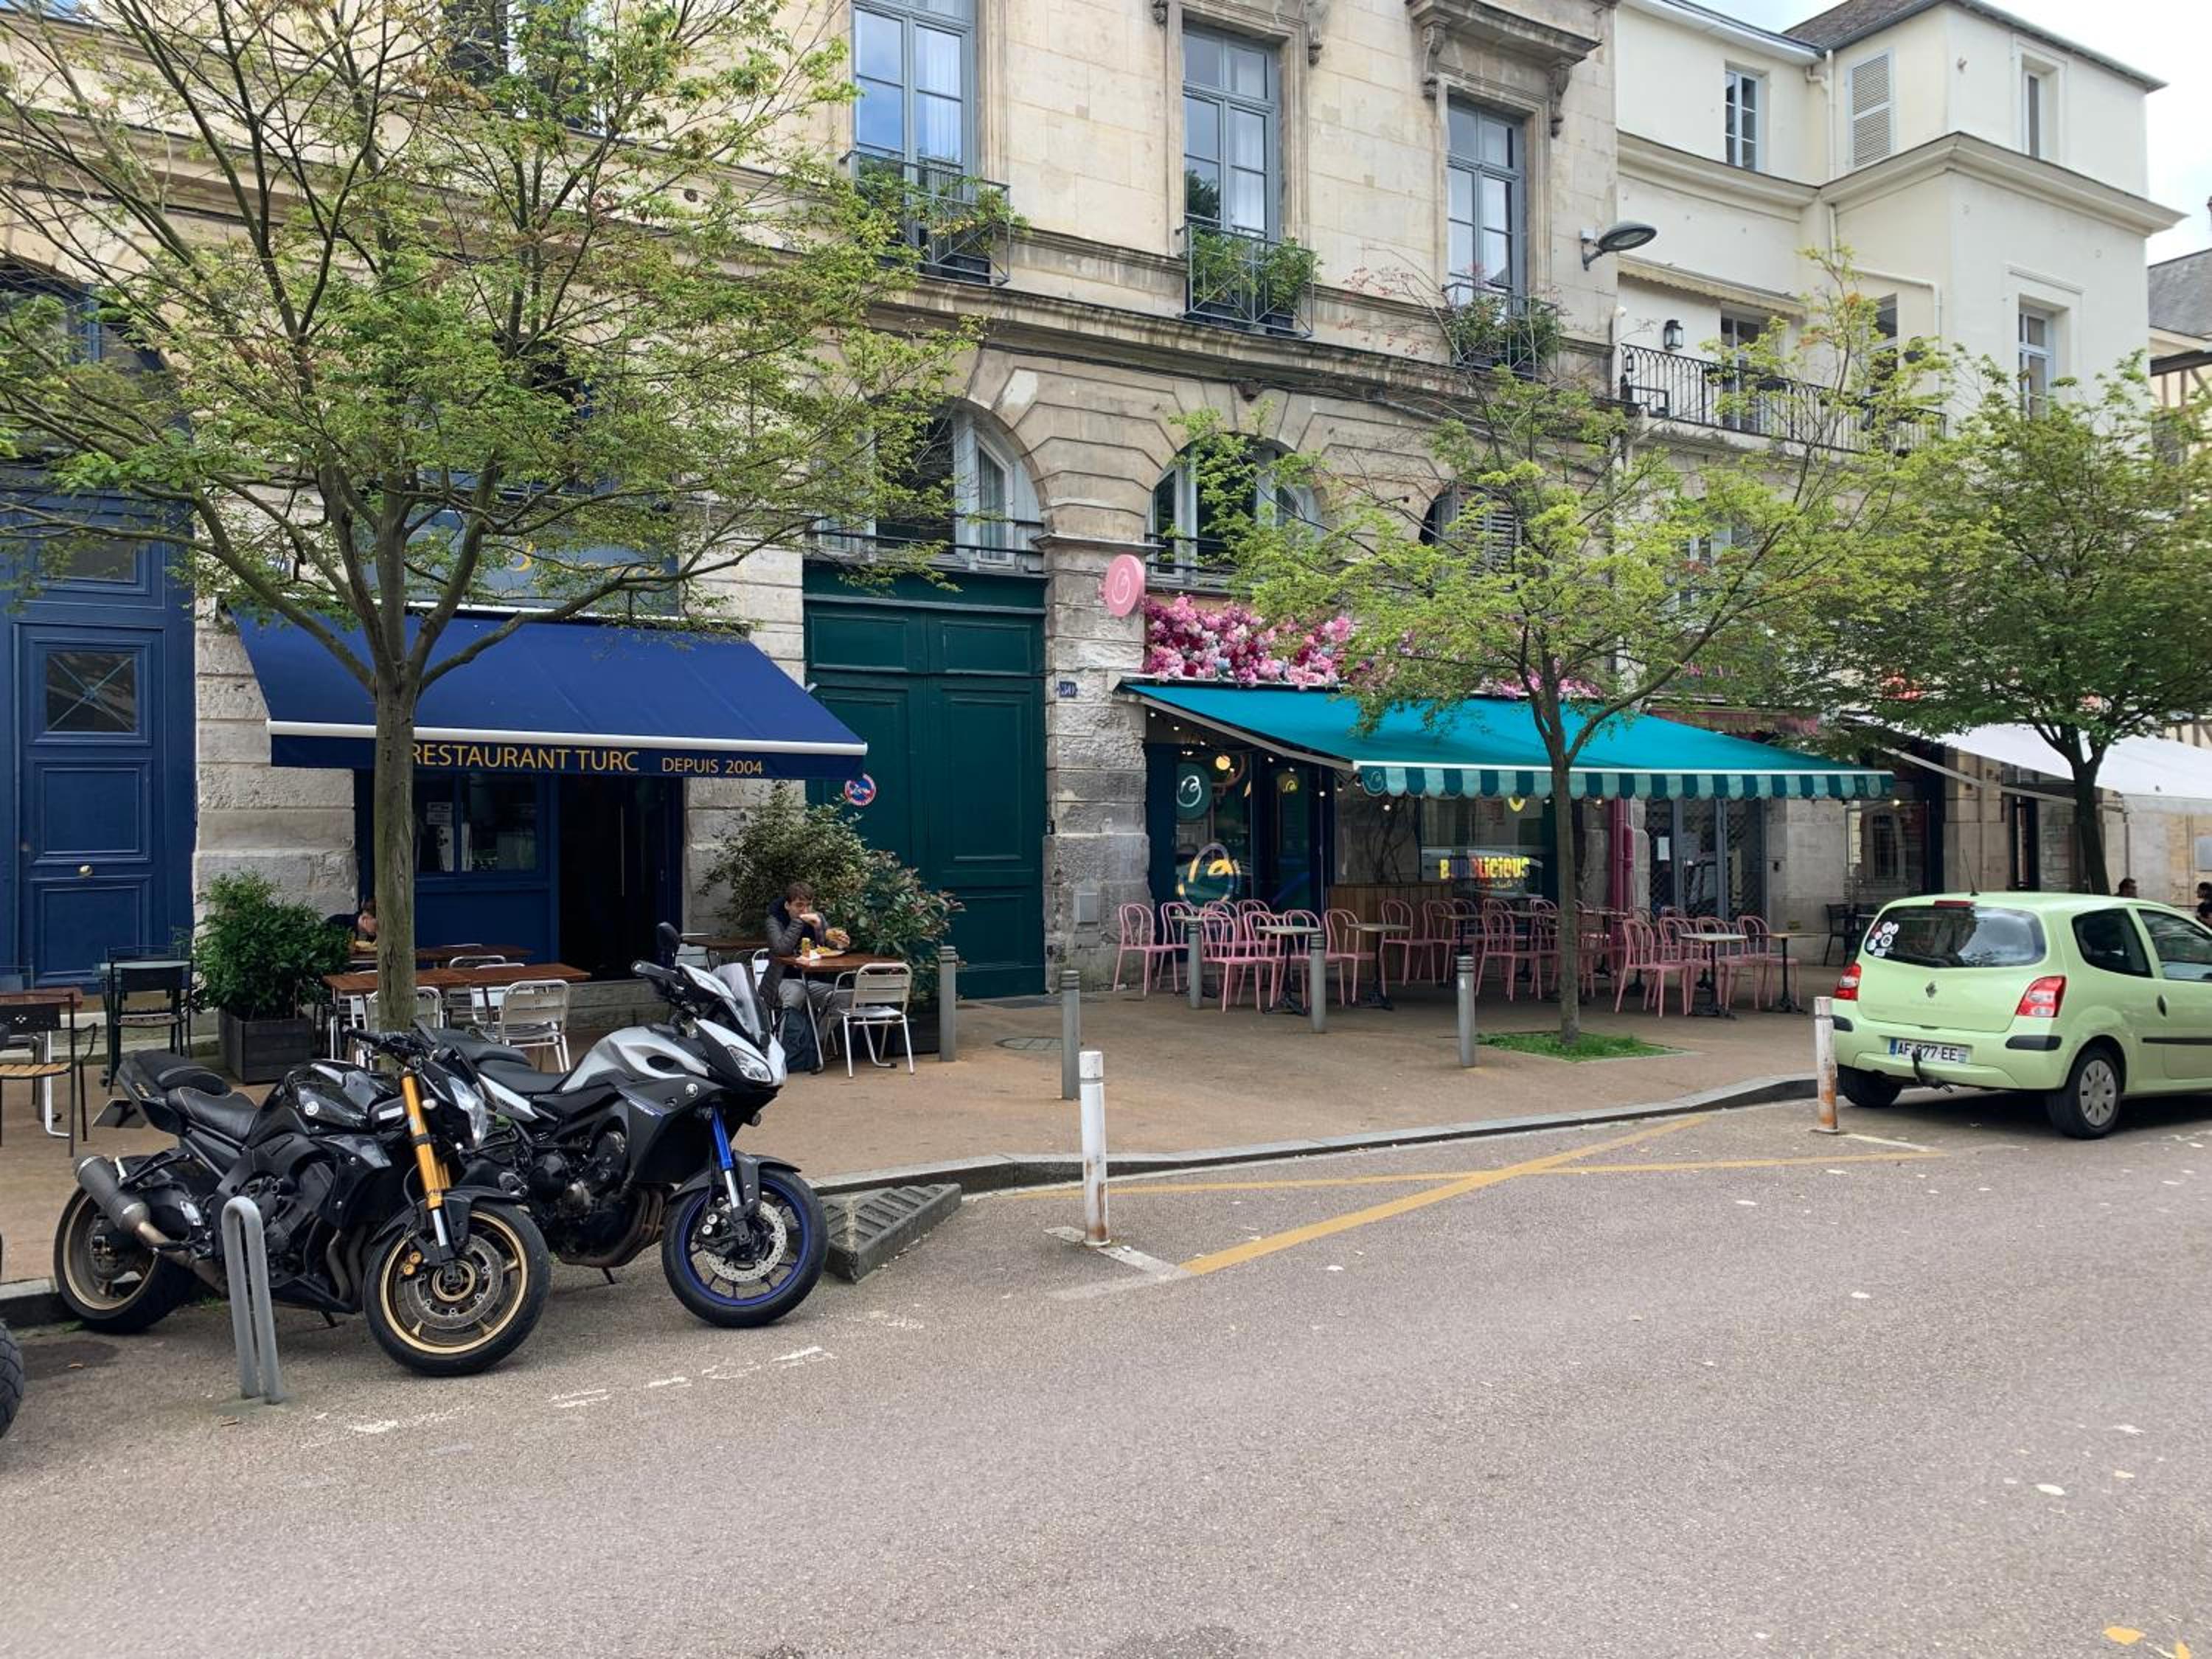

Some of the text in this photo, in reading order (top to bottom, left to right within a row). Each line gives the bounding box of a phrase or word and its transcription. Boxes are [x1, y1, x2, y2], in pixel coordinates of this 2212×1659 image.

[413, 743, 762, 775] RESTAURANT TURC DEPUIS 2004
